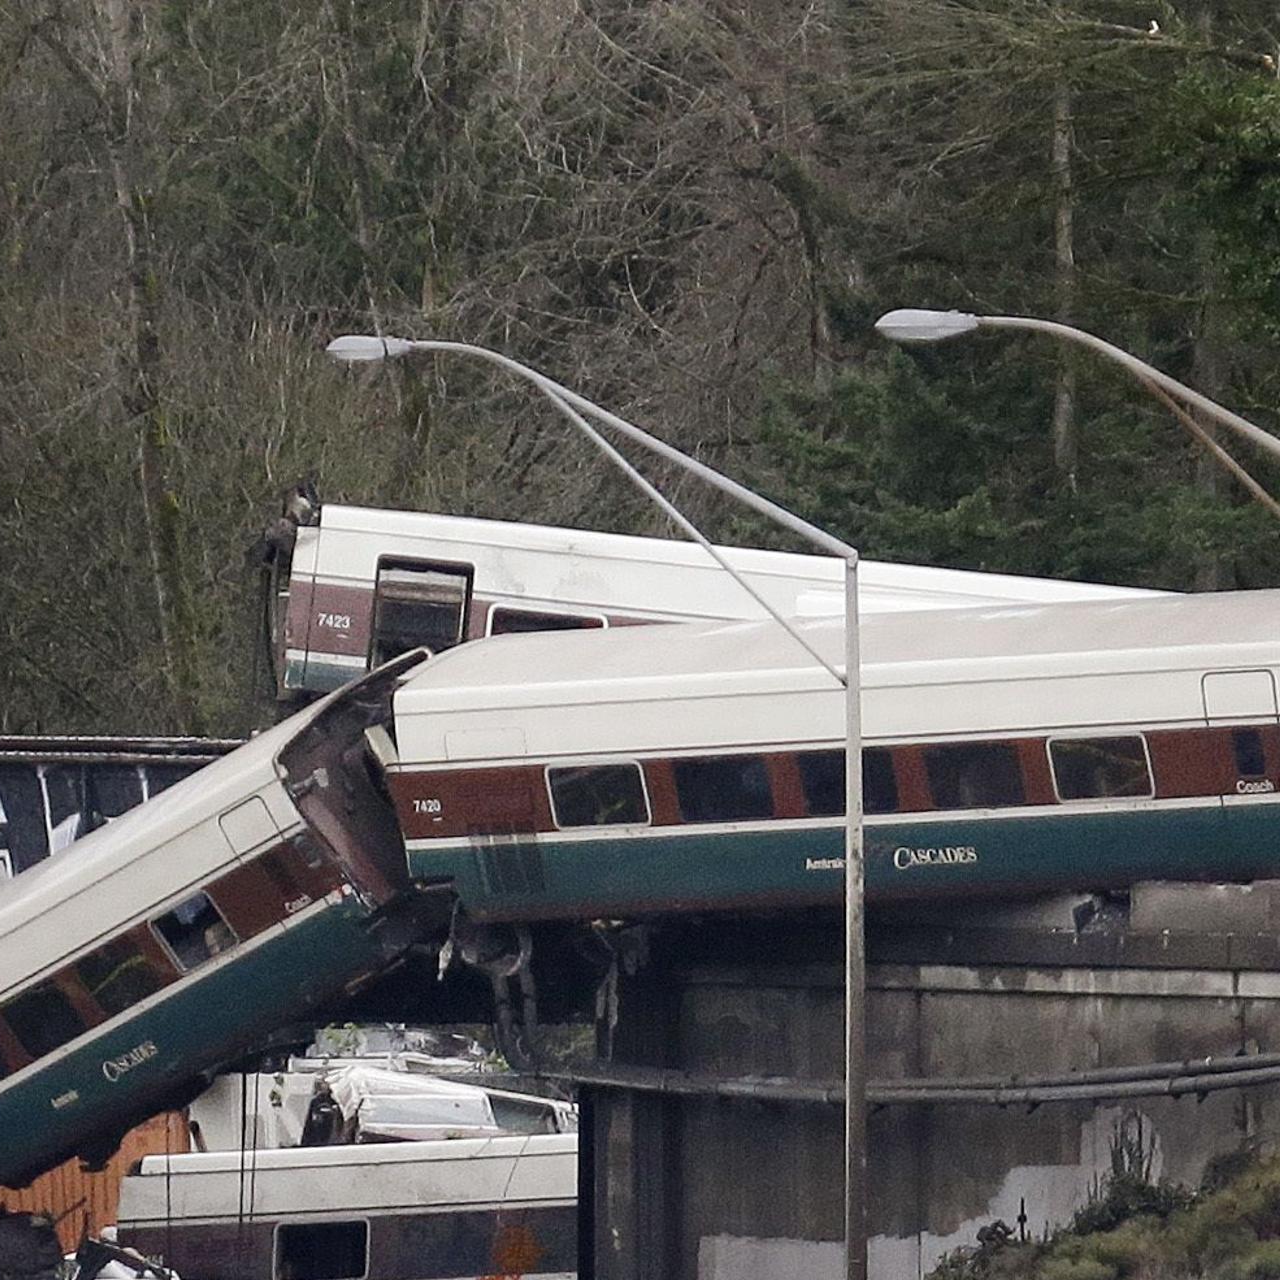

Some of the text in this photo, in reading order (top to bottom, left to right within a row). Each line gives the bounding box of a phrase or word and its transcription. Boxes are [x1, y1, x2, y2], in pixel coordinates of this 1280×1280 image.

[318, 612, 351, 629] 7423
[1236, 778, 1274, 794] Coach
[413, 799, 441, 813] 7420
